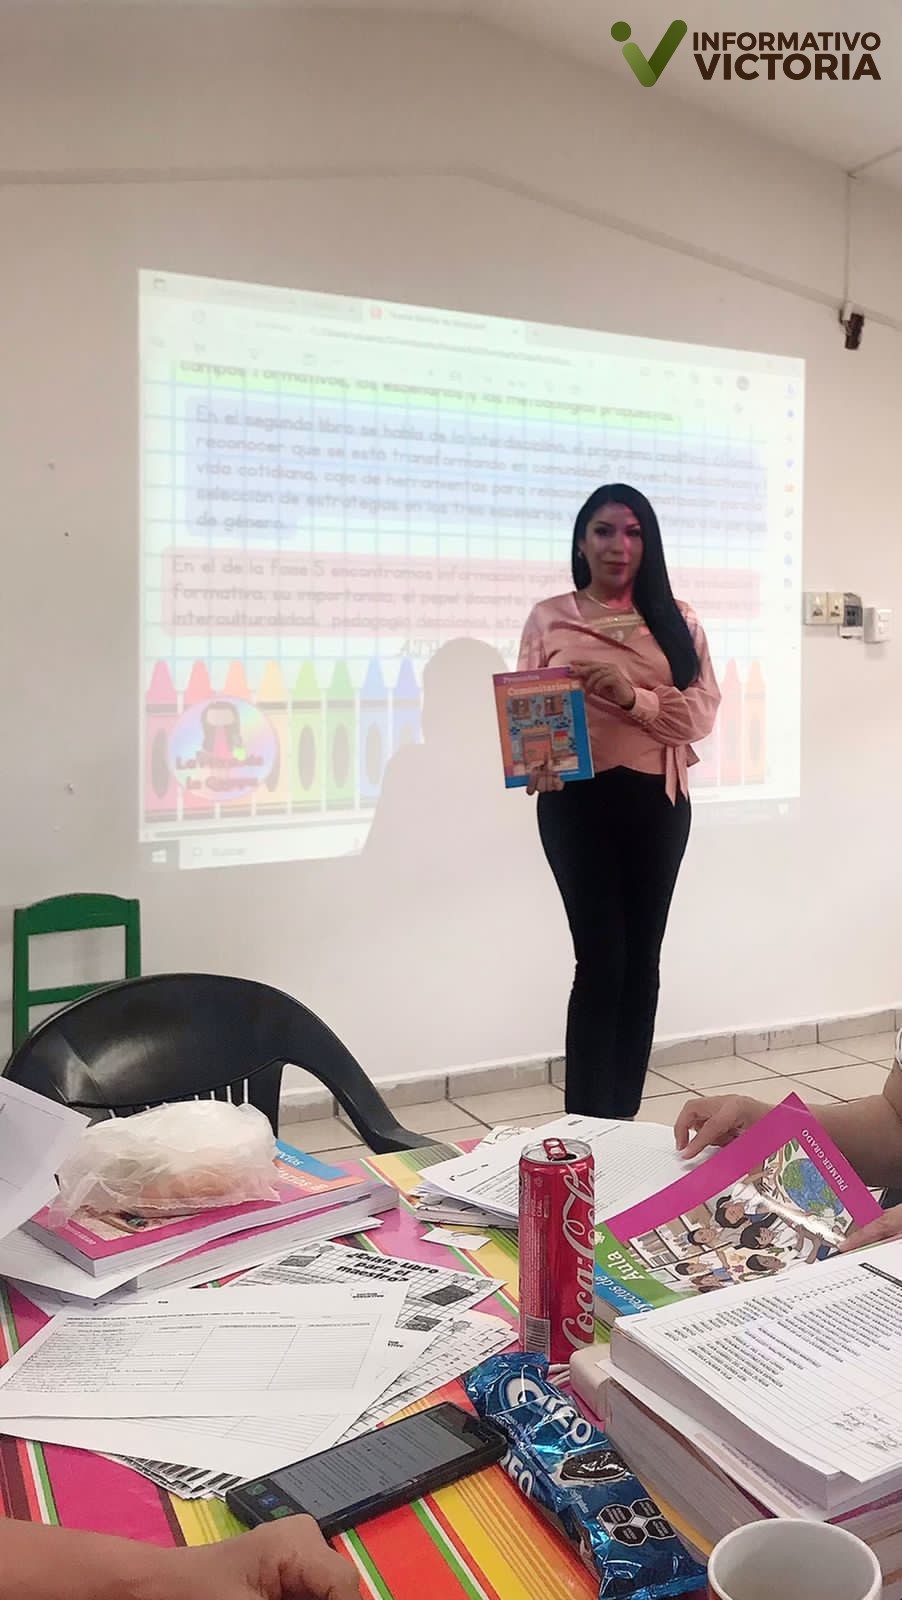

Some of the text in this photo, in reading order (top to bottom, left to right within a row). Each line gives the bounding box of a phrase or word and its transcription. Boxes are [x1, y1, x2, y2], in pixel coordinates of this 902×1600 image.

[801, 1129, 849, 1192] PRIMER GRADO
[353, 1262, 391, 1273] para
[607, 1250, 645, 1281] Aula
[608, 1284, 654, 1313] oyectos
[499, 1452, 537, 1498] EO
